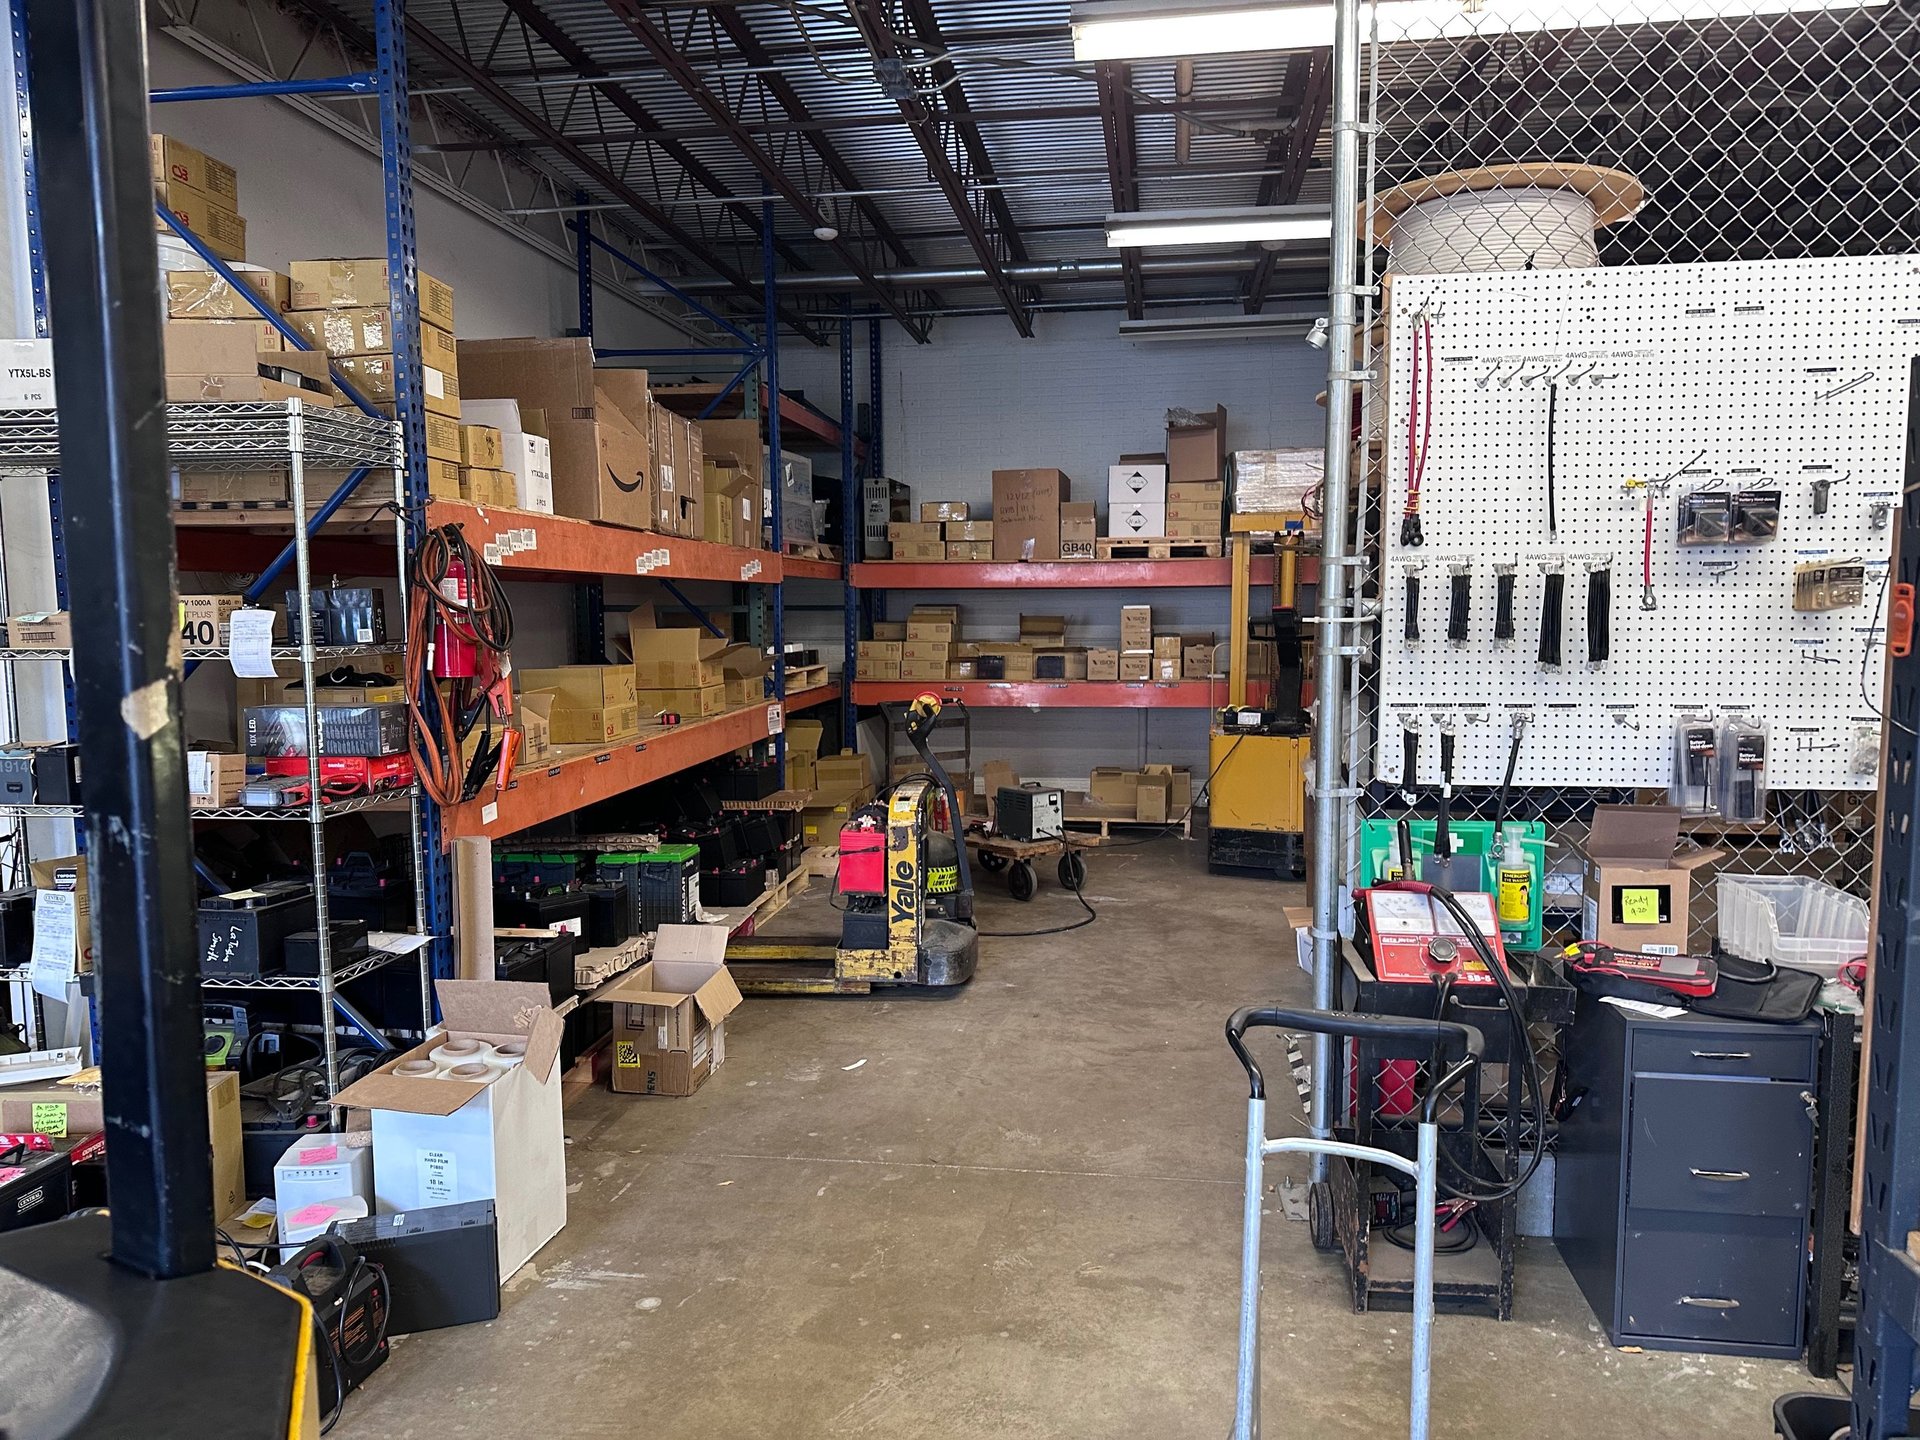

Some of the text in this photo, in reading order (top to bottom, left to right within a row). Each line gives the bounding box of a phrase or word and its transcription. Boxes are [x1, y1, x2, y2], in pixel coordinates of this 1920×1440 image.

[1565, 351, 1588, 359] 4AWG
[8, 368, 52, 378] YTX5L-BS
[30, 393, 42, 401] PCS
[1062, 543, 1092, 553] GB40
[182, 621, 214, 645] 40
[249, 717, 257, 733] LED.
[891, 861, 915, 924] Yale
[1624, 896, 1649, 906] Ready
